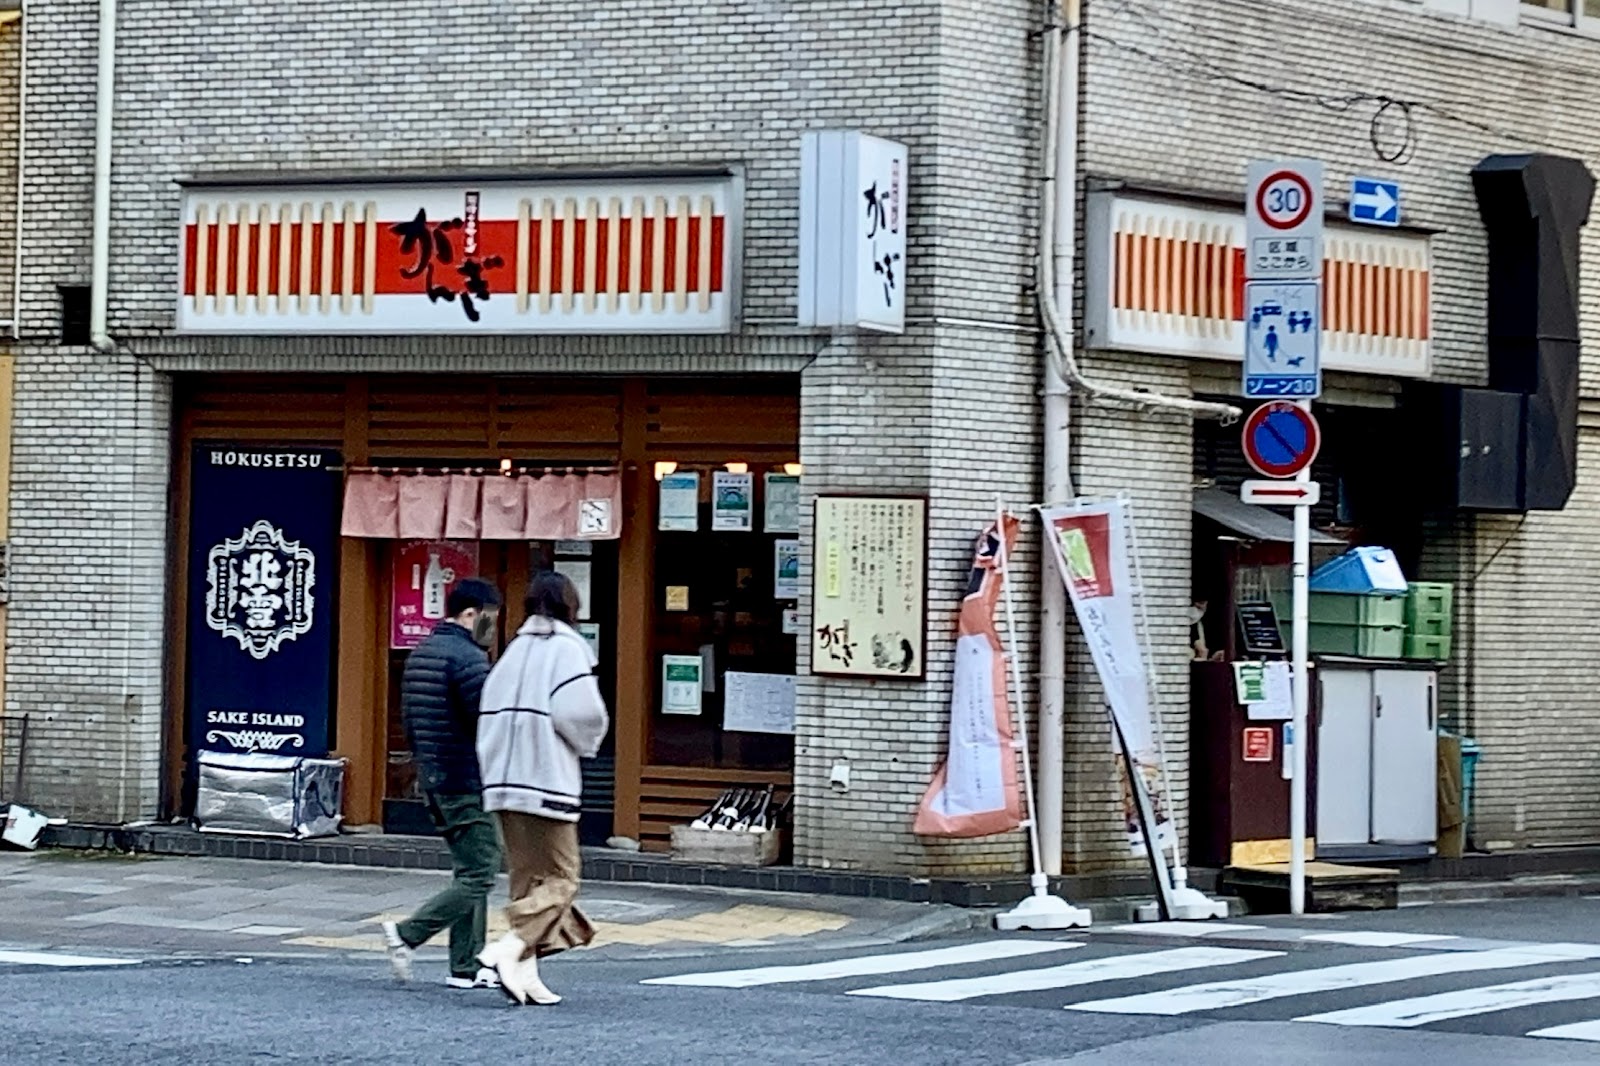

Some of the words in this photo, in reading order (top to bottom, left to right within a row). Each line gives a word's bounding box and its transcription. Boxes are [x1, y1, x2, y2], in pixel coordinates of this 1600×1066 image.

[1268, 187, 1301, 213] 30
[1257, 255, 1310, 269] ここから
[211, 451, 322, 467] HOKUSETSU
[207, 711, 248, 724] SAKE
[252, 713, 304, 727] ISLAND
